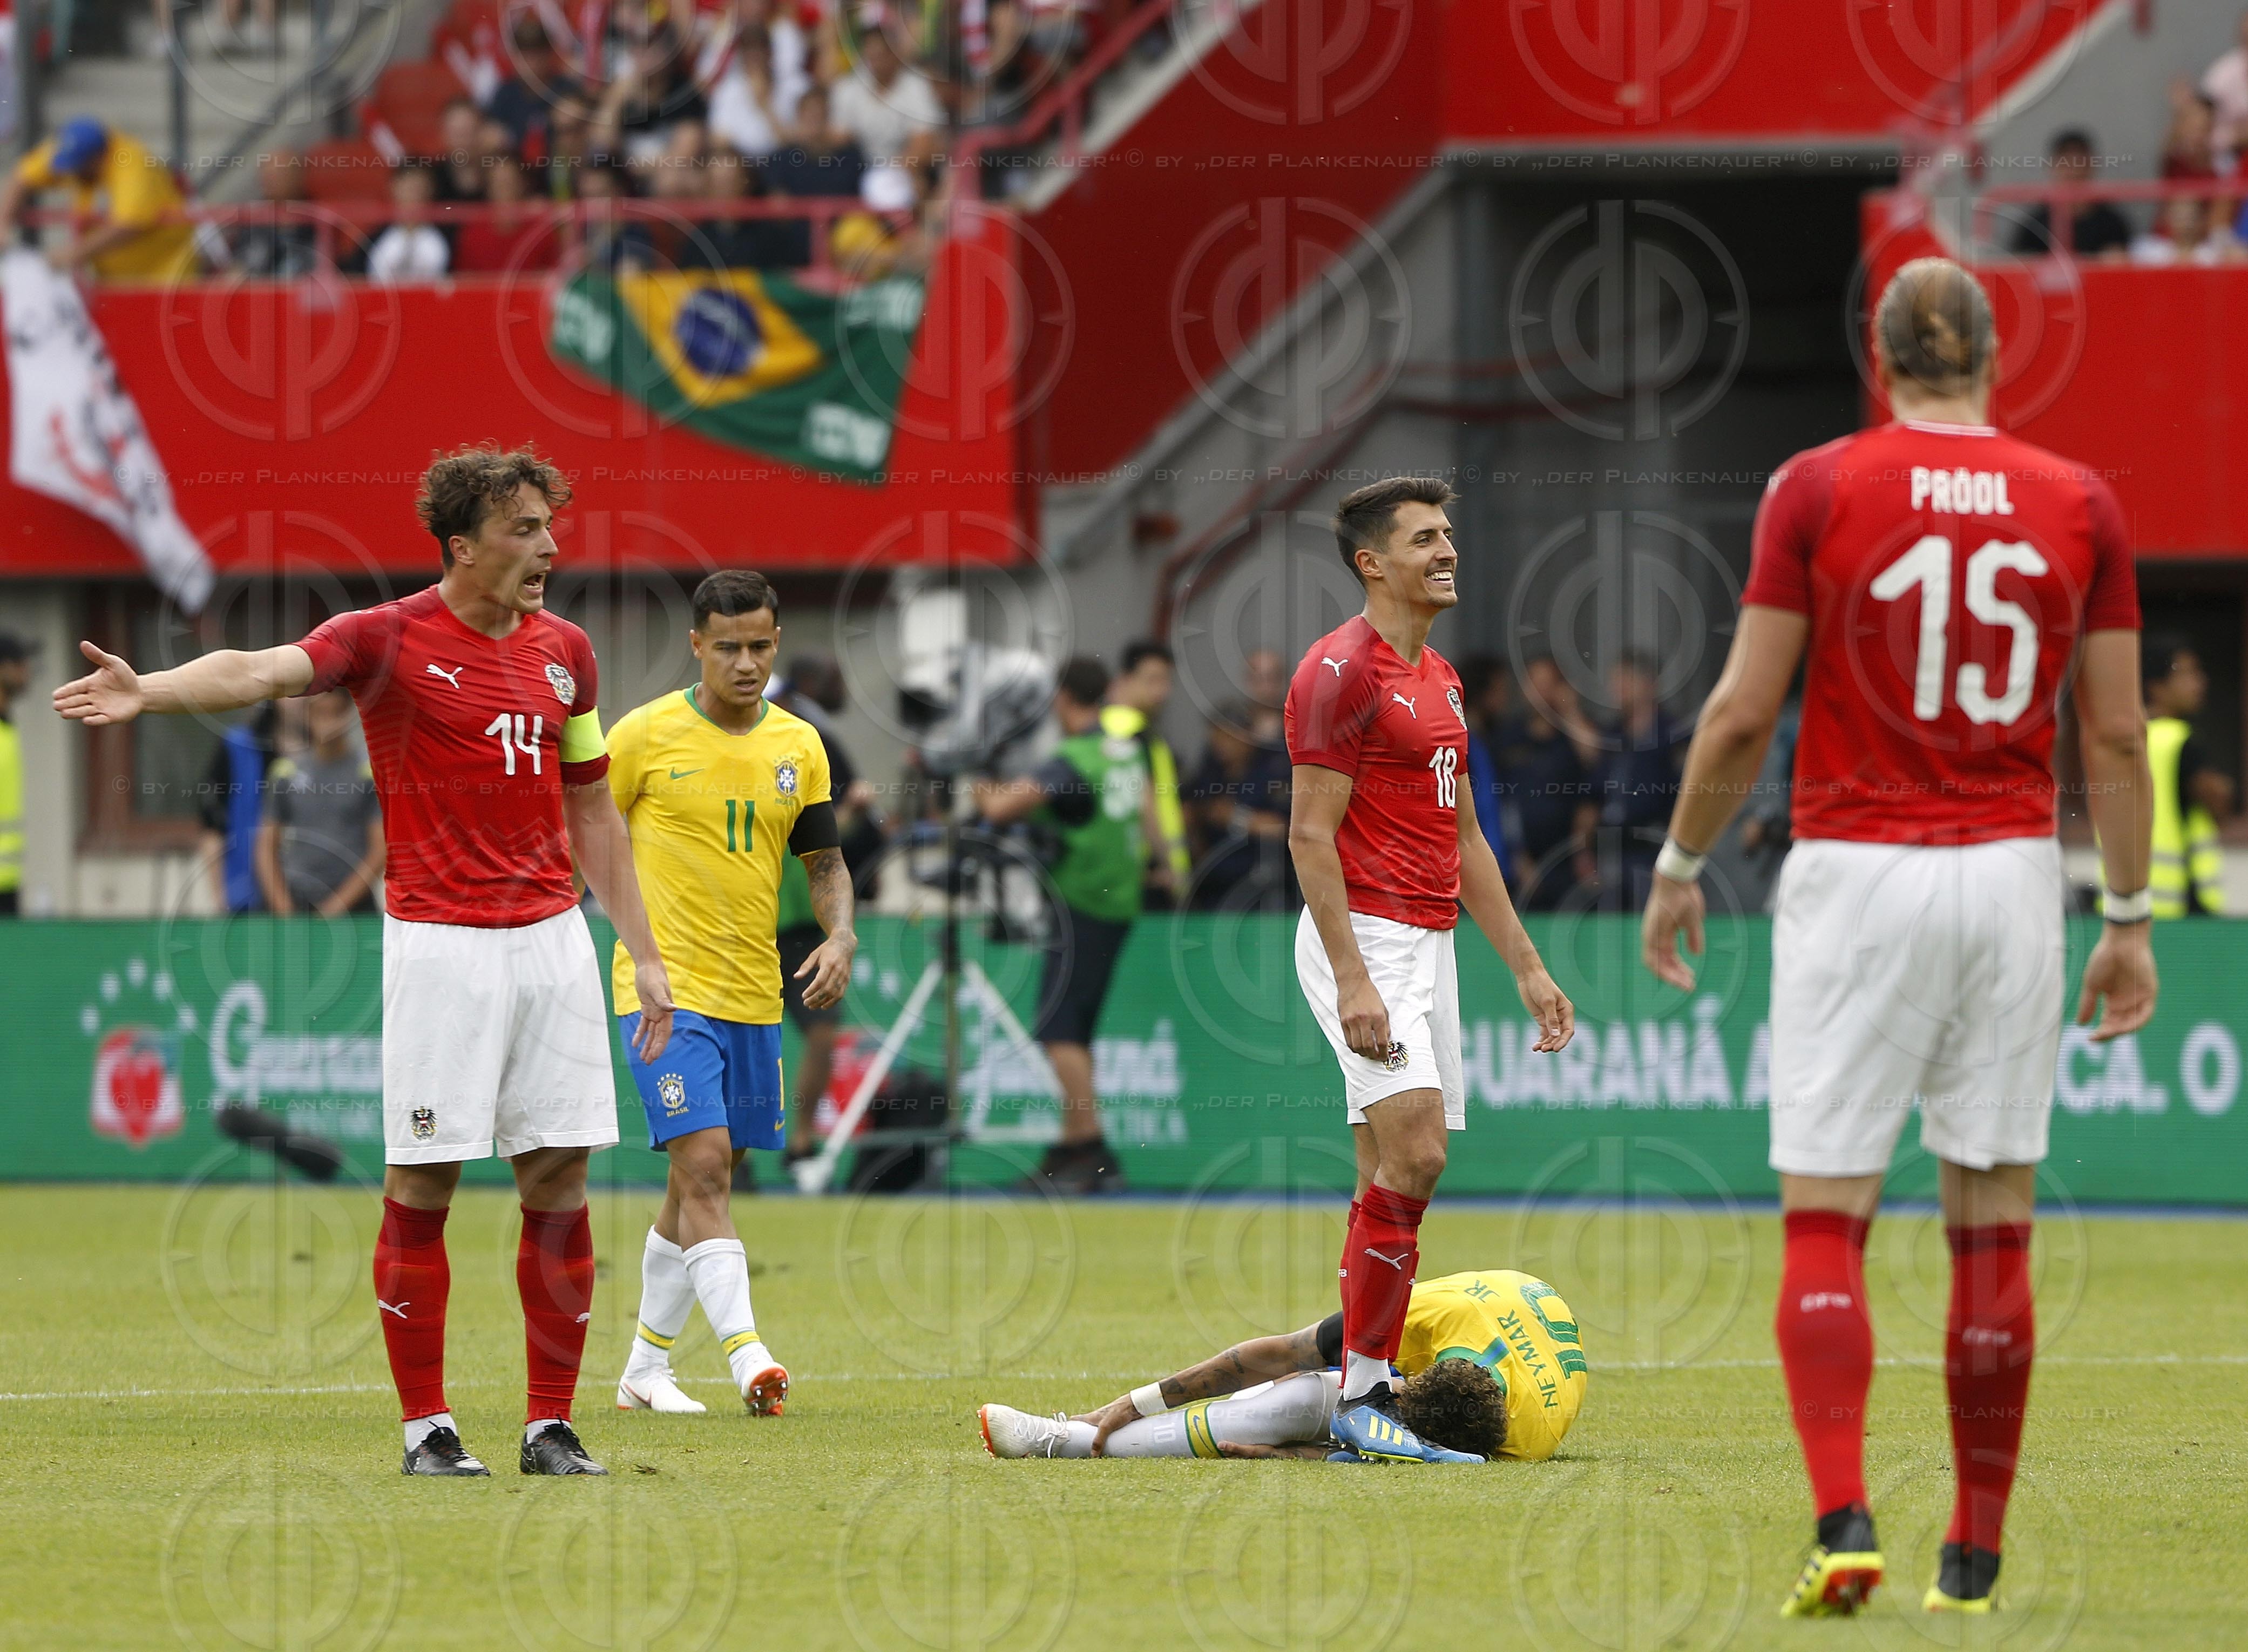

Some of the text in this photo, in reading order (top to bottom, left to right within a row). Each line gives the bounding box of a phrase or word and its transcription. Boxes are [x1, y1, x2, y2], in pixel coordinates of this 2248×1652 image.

[1869, 534, 2049, 727] 15
[484, 713, 544, 776] 14
[1428, 746, 1458, 809] 18
[726, 799, 755, 852] 11
[667, 1106, 689, 1118] BRASIL
[1464, 1279, 1559, 1409] NEYMAR JR
